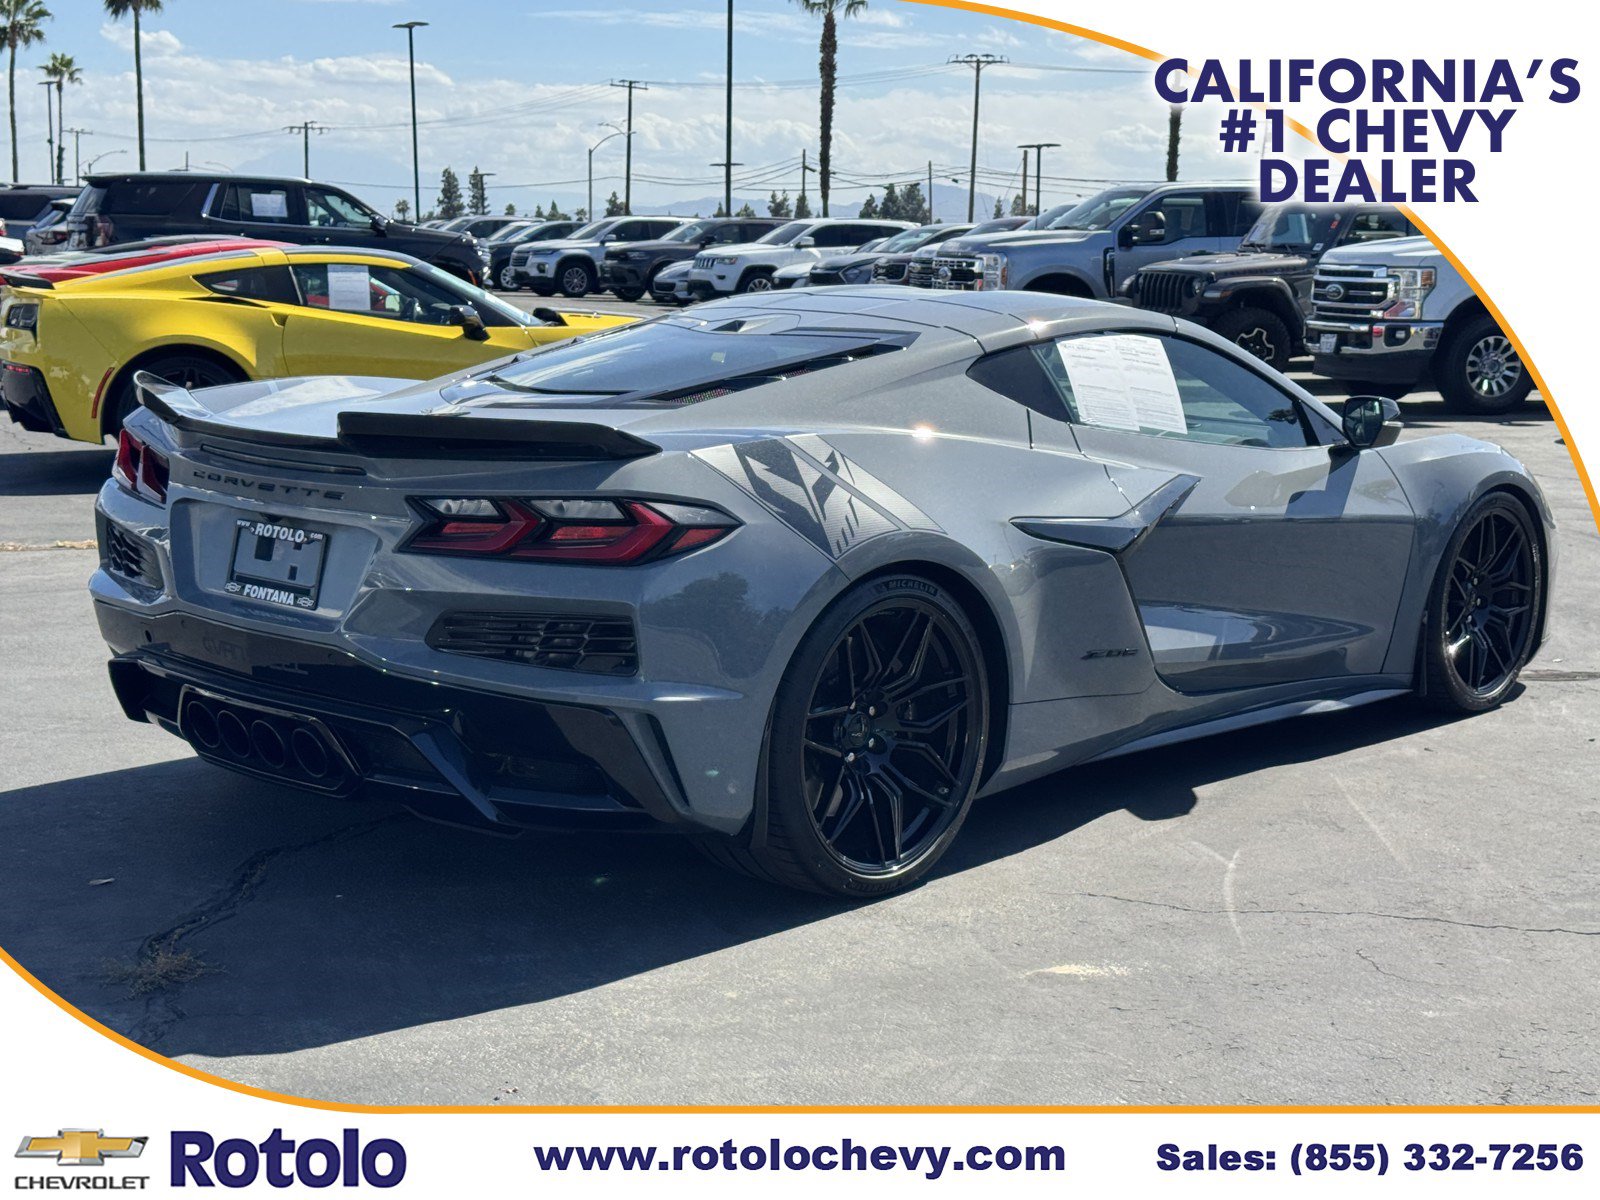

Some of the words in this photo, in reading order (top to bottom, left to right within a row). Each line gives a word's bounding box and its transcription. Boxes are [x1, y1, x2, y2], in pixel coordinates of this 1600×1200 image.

[193, 470, 345, 500] CORVETTE
[243, 583, 295, 605] FONTANA
[888, 580, 937, 595] MICHELIN
